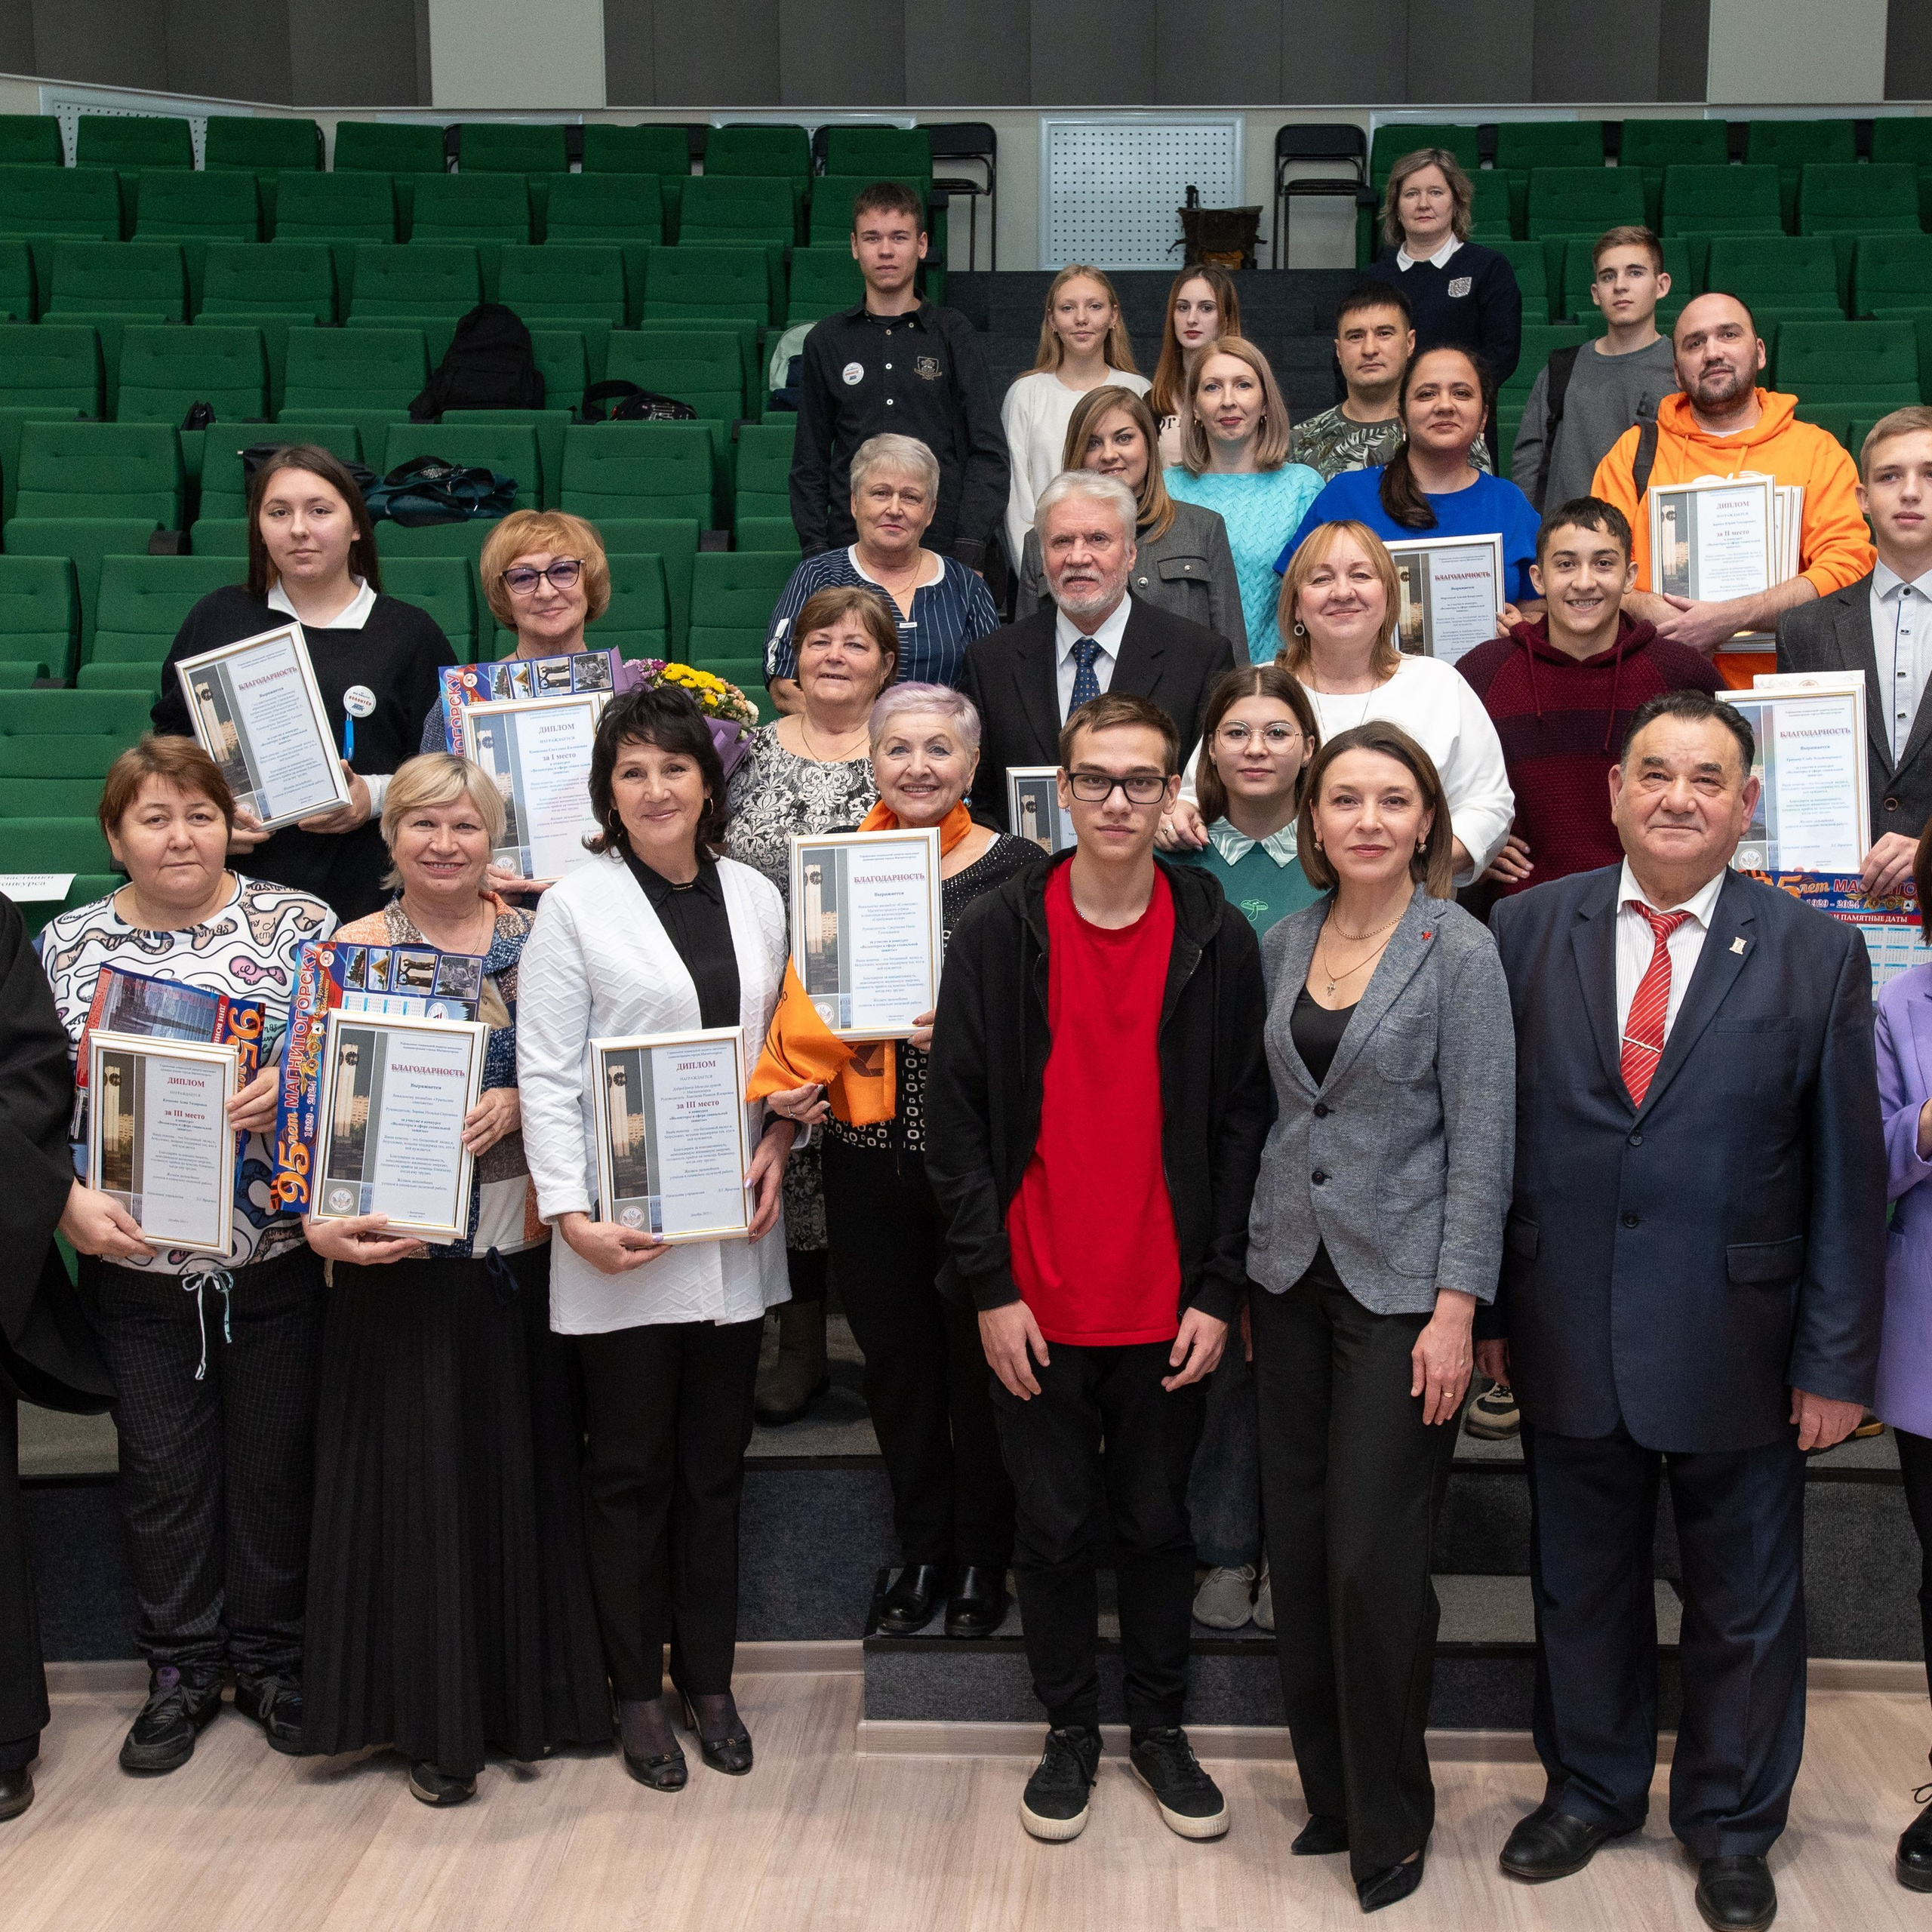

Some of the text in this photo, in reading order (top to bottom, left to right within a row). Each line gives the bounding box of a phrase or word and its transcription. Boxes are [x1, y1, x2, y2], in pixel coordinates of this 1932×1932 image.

[238, 666, 297, 691] БЛАГОДАРНОСТЬ
[447, 675, 465, 757] ТОГОРСКУ
[539, 724, 574, 734] ДИПЛОМ
[1780, 728, 1850, 738] БЛАГОДАРНОСТЬ
[854, 873, 925, 884] БЛАГОДАРНОСТЬ
[1799, 881, 1829, 894] лет
[1837, 899, 1860, 909] 2024
[1841, 914, 1885, 922] ПАМЯТНЫЕ
[1885, 915, 1908, 924] ДАТЫ
[315, 970, 325, 998] Трудовой
[320, 979, 331, 1011] Доблести
[391, 1064, 465, 1077] БЛАГОДАРНОСТЬ
[676, 1060, 716, 1071] ДИПЛОМ
[278, 947, 317, 1204] 95 лет МАГНИТОГОРСКУ
[168, 1077, 205, 1088] ДИПЛОМ
[307, 1079, 316, 1106] 2024
[304, 1112, 313, 1138] 1929
